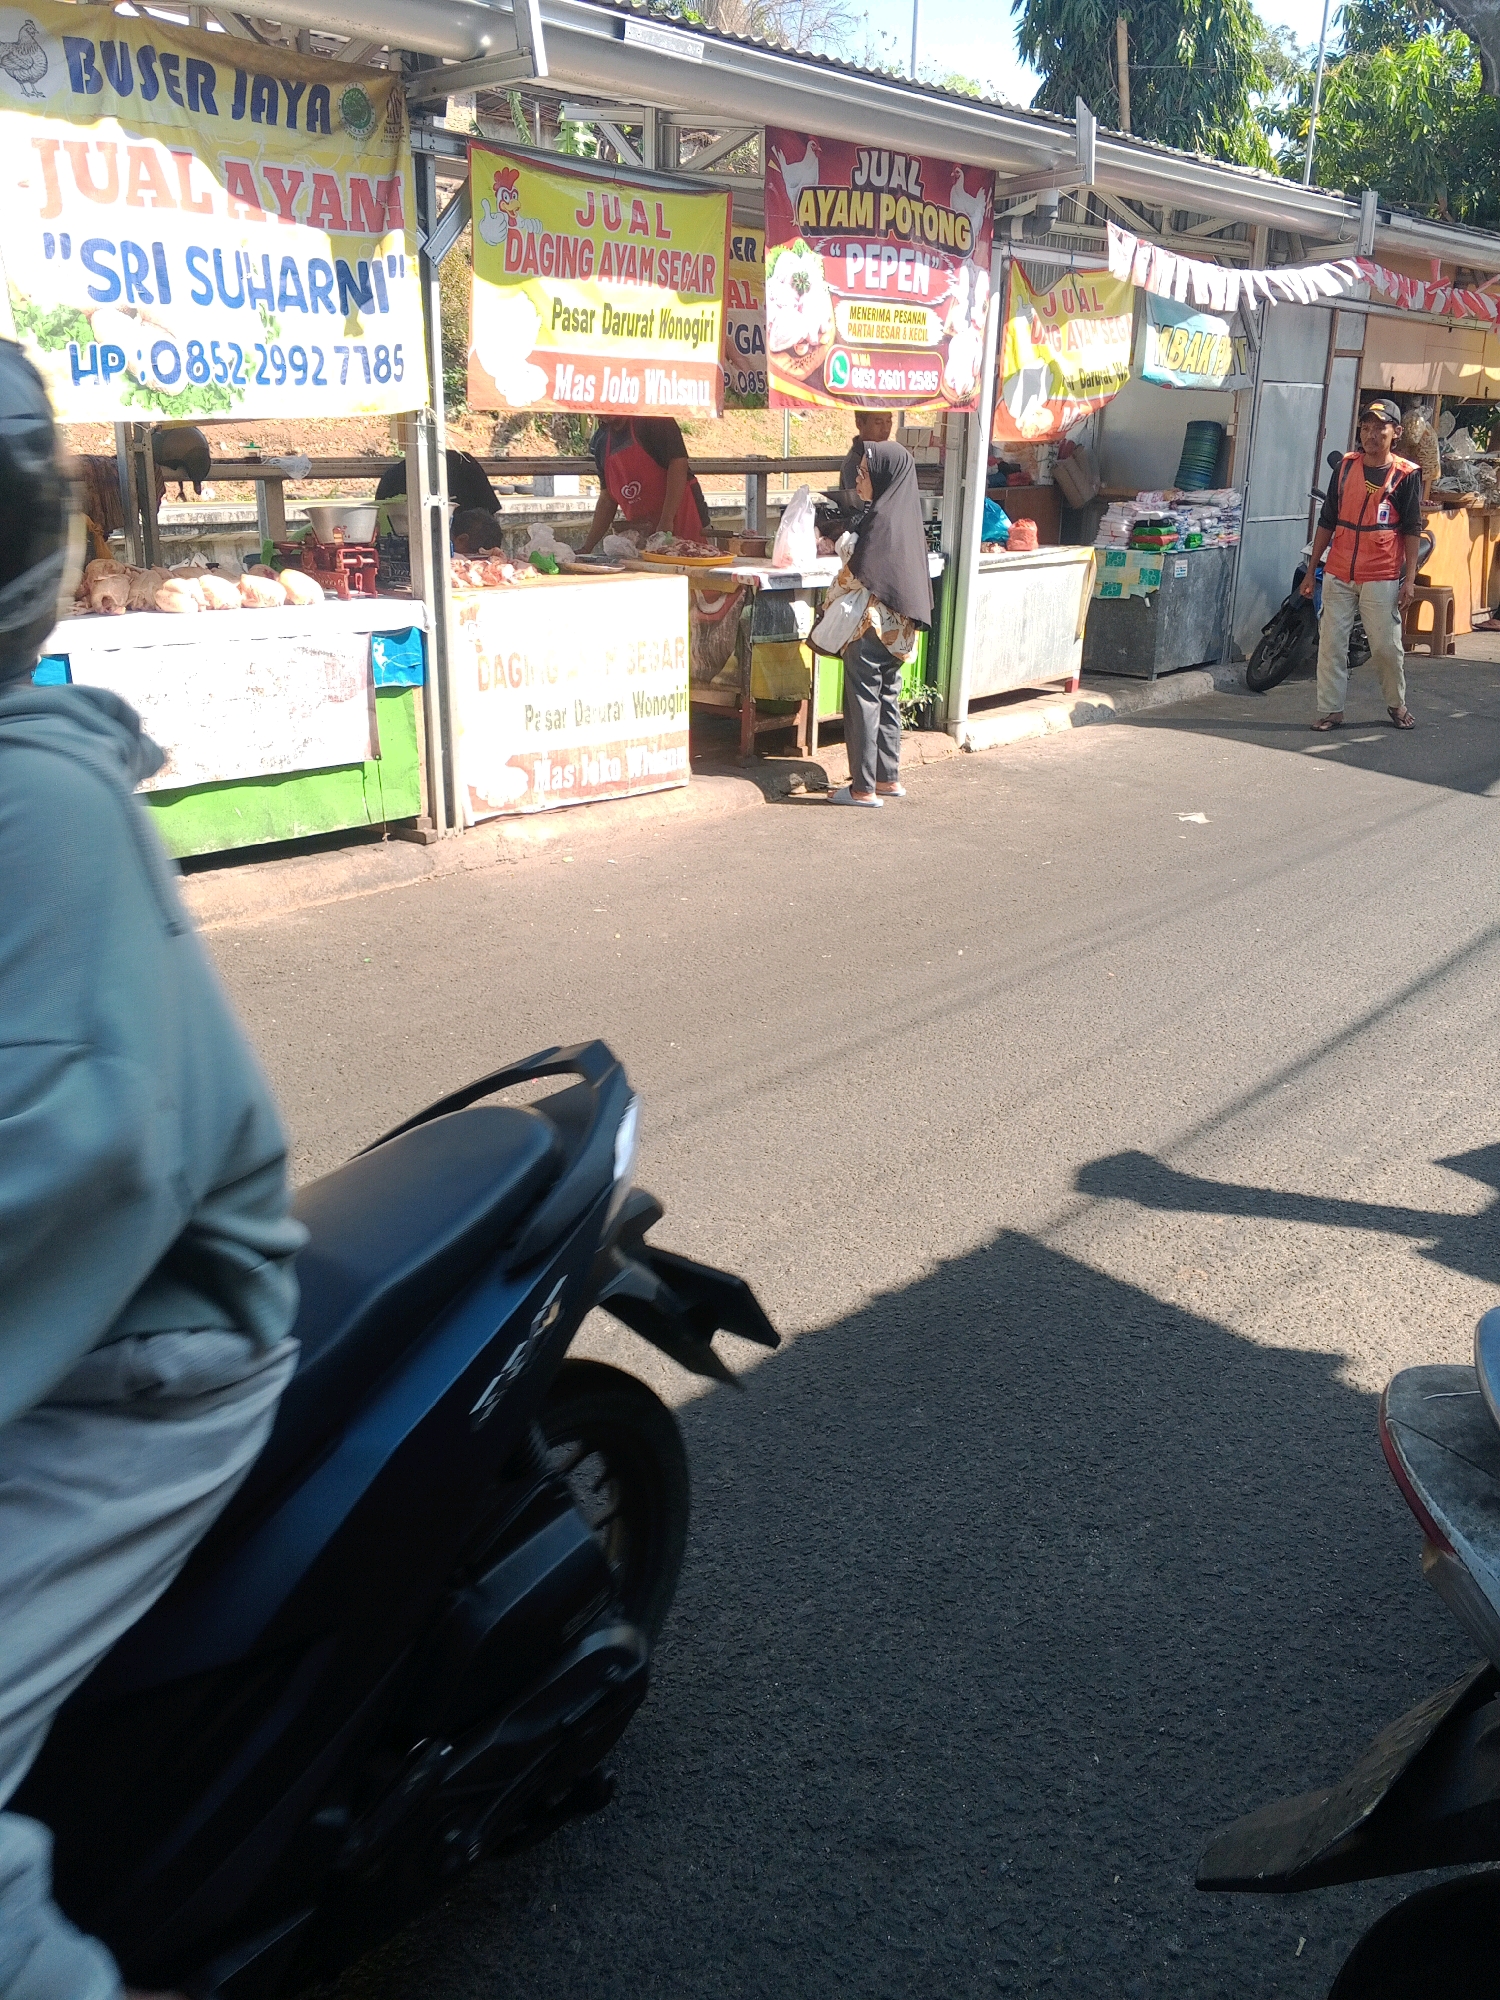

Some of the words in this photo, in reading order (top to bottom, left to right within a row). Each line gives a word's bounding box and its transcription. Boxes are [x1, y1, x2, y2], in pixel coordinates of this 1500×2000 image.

[63, 36, 219, 115] BUSER
[231, 68, 331, 135] JAYA
[31, 137, 214, 219] JUAL
[223, 160, 405, 234] AYAM
[854, 150, 923, 196] JUAL
[575, 191, 671, 240] JUAL
[800, 189, 874, 229] AYAM
[879, 193, 971, 251] POTONG
[504, 228, 595, 282] DAGING
[597, 241, 655, 288] AYAM
[656, 249, 716, 295] SEGAR
[551, 297, 596, 334] Pasar
[602, 303, 655, 339] Darurat
[659, 308, 715, 349] Wonogiri
[849, 305, 891, 323] MENERIMA
[894, 309, 927, 325] PESANAN
[1043, 287, 1104, 318] JUAL
[847, 322, 875, 339] PARTAI
[876, 325, 901, 340] BESAR
[902, 326, 907, 341] &
[908, 327, 929, 342] KECIL
[1154, 322, 1218, 376] MBAK
[255, 342, 328, 386] 2992
[333, 343, 404, 386] 7785
[553, 363, 597, 403] Mas
[600, 366, 640, 405] Joko
[644, 369, 711, 407] Whisnu
[878, 369, 906, 391] 2601
[632, 684, 688, 720] Wonogiri
[533, 758, 575, 793] Mas
